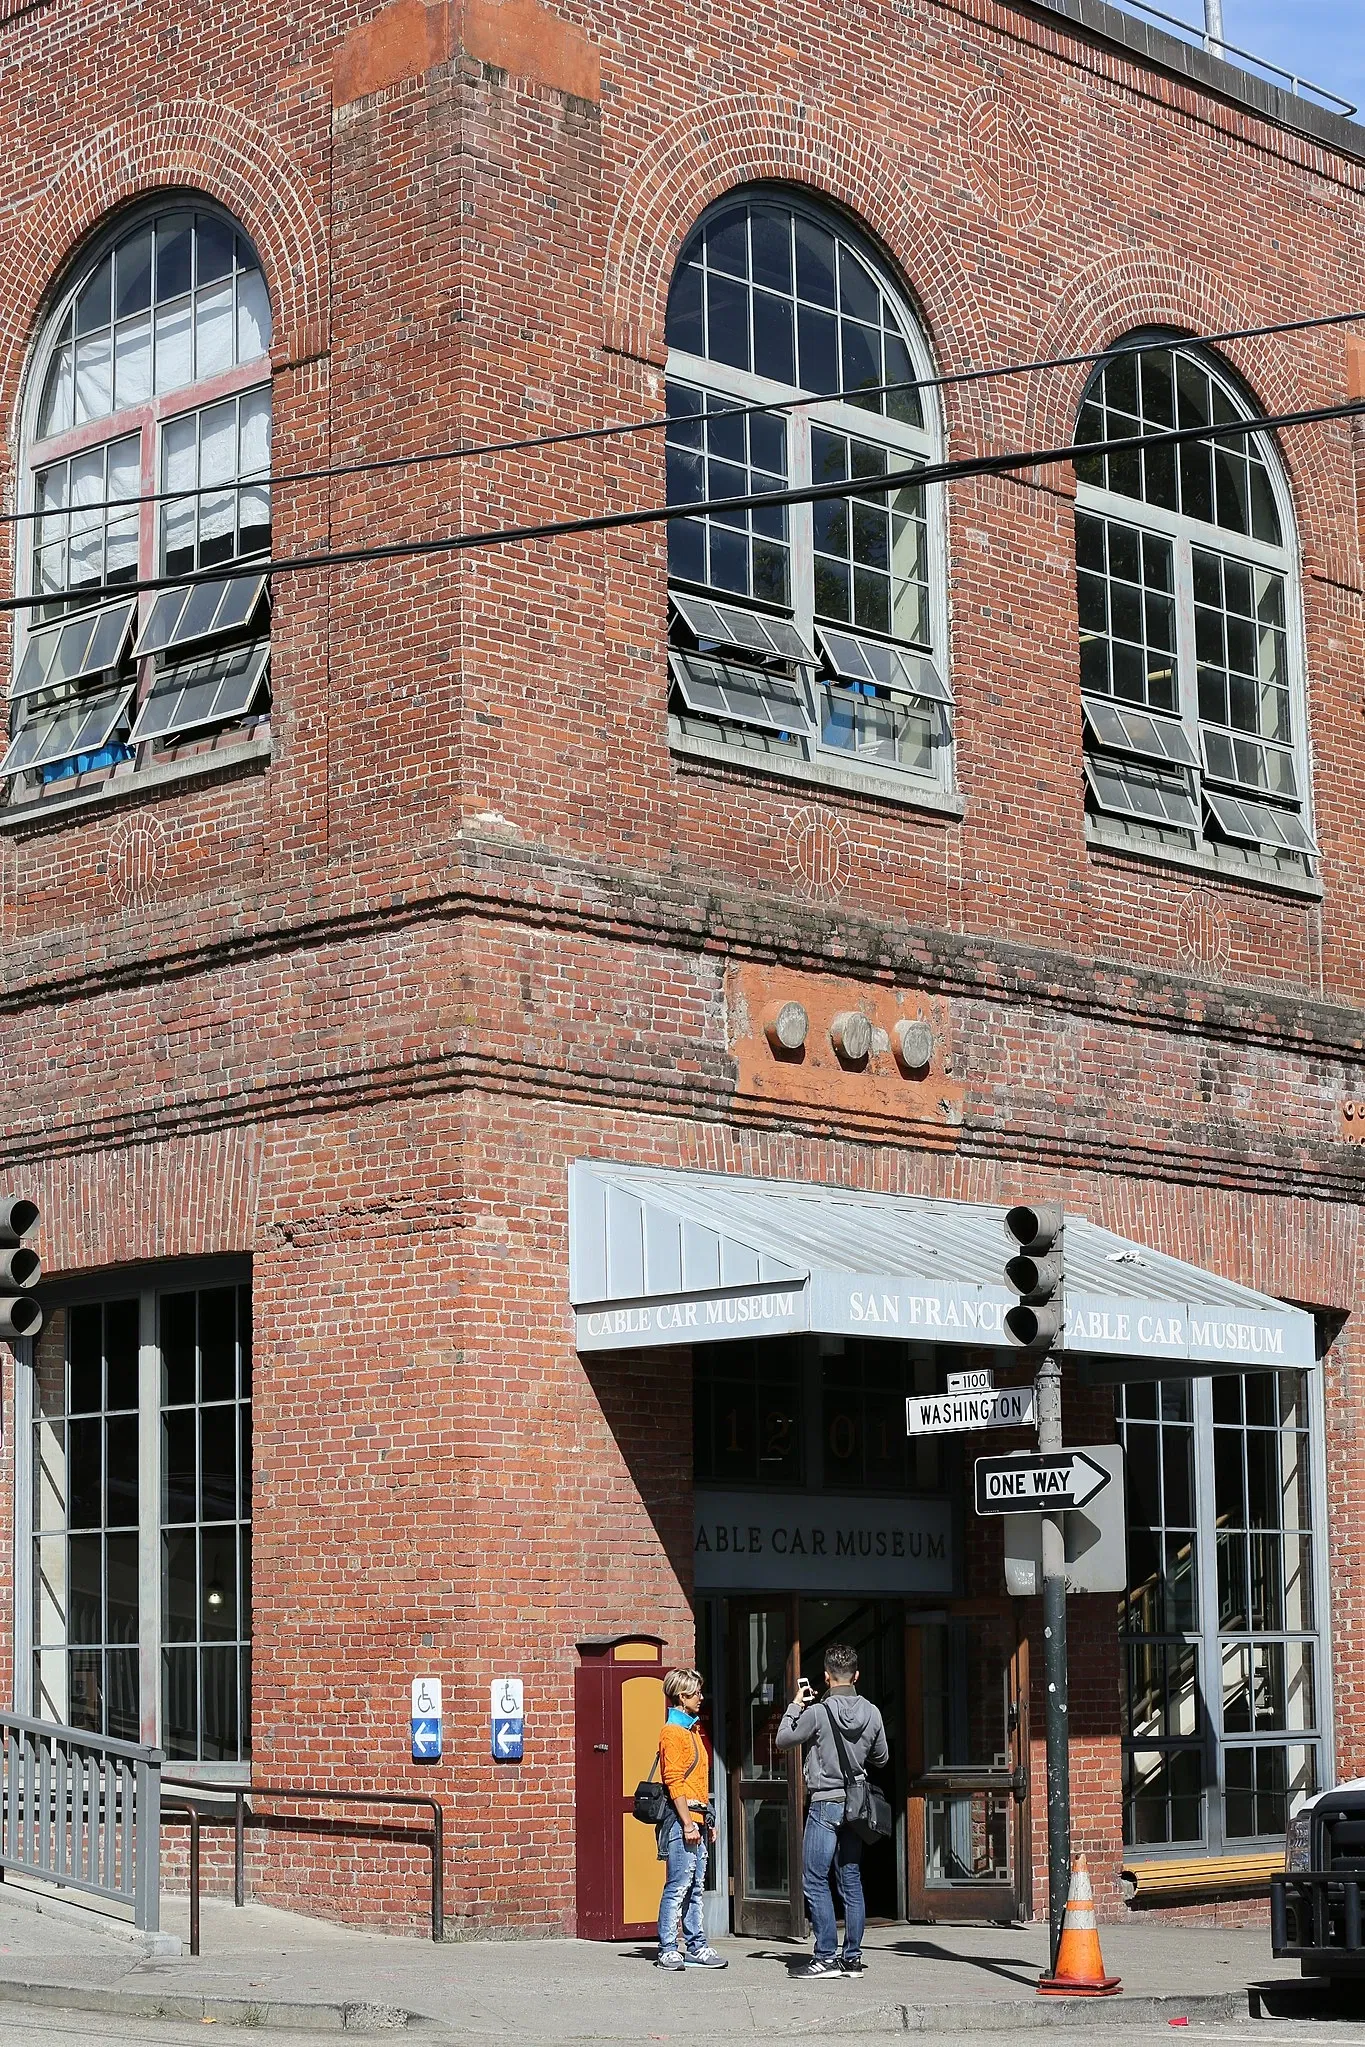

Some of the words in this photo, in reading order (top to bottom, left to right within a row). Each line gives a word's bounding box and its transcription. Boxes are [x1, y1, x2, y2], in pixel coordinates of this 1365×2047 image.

[587, 1309, 651, 1336] CABLE
[656, 1302, 699, 1330] CAR
[704, 1292, 795, 1325] MUSEUM
[849, 1292, 900, 1323] SAN
[907, 1296, 1015, 1331] FRANCI
[1137, 1315, 1186, 1345] CAR
[1190, 1320, 1284, 1354] MUSEUM
[962, 1373, 987, 1389] 1100
[920, 1396, 1022, 1426] WASHINGTON
[989, 1473, 1027, 1496] ONE
[1032, 1470, 1071, 1494] WAY
[695, 1524, 762, 1554] ABLE
[771, 1527, 827, 1556] CAR
[835, 1528, 946, 1559] MUSEUM
